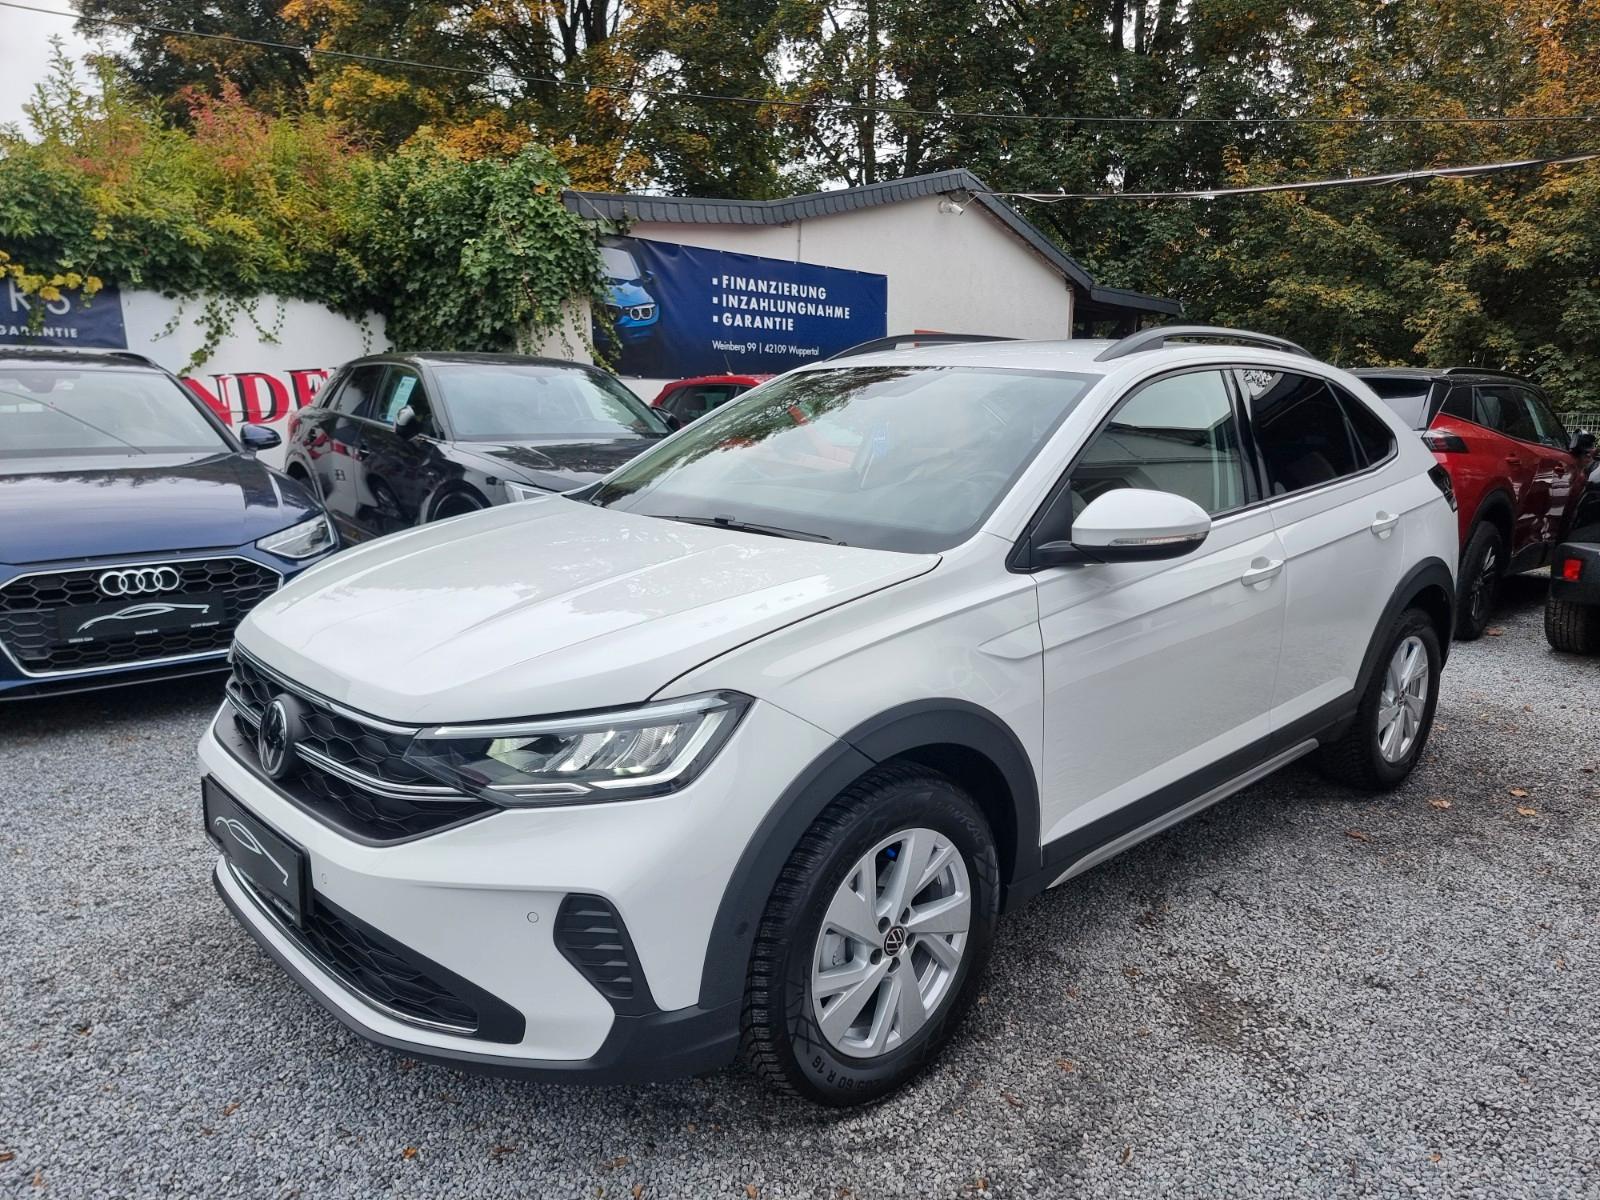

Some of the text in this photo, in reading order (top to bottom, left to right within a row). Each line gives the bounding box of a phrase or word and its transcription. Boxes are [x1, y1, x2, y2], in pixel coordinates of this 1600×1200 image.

[722, 275, 827, 300] FINANZIERUNG
[722, 294, 850, 319] INZAHLUNGNAHME
[722, 312, 794, 331] GARANTIE
[0, 325, 78, 338] GARNTIE
[712, 340, 746, 354] Weinberg
[747, 342, 757, 352] 99
[764, 344, 787, 354] 42109
[788, 345, 820, 357] Wuppertal
[812, 1056, 826, 1074] 16
[826, 1070, 837, 1084] R
